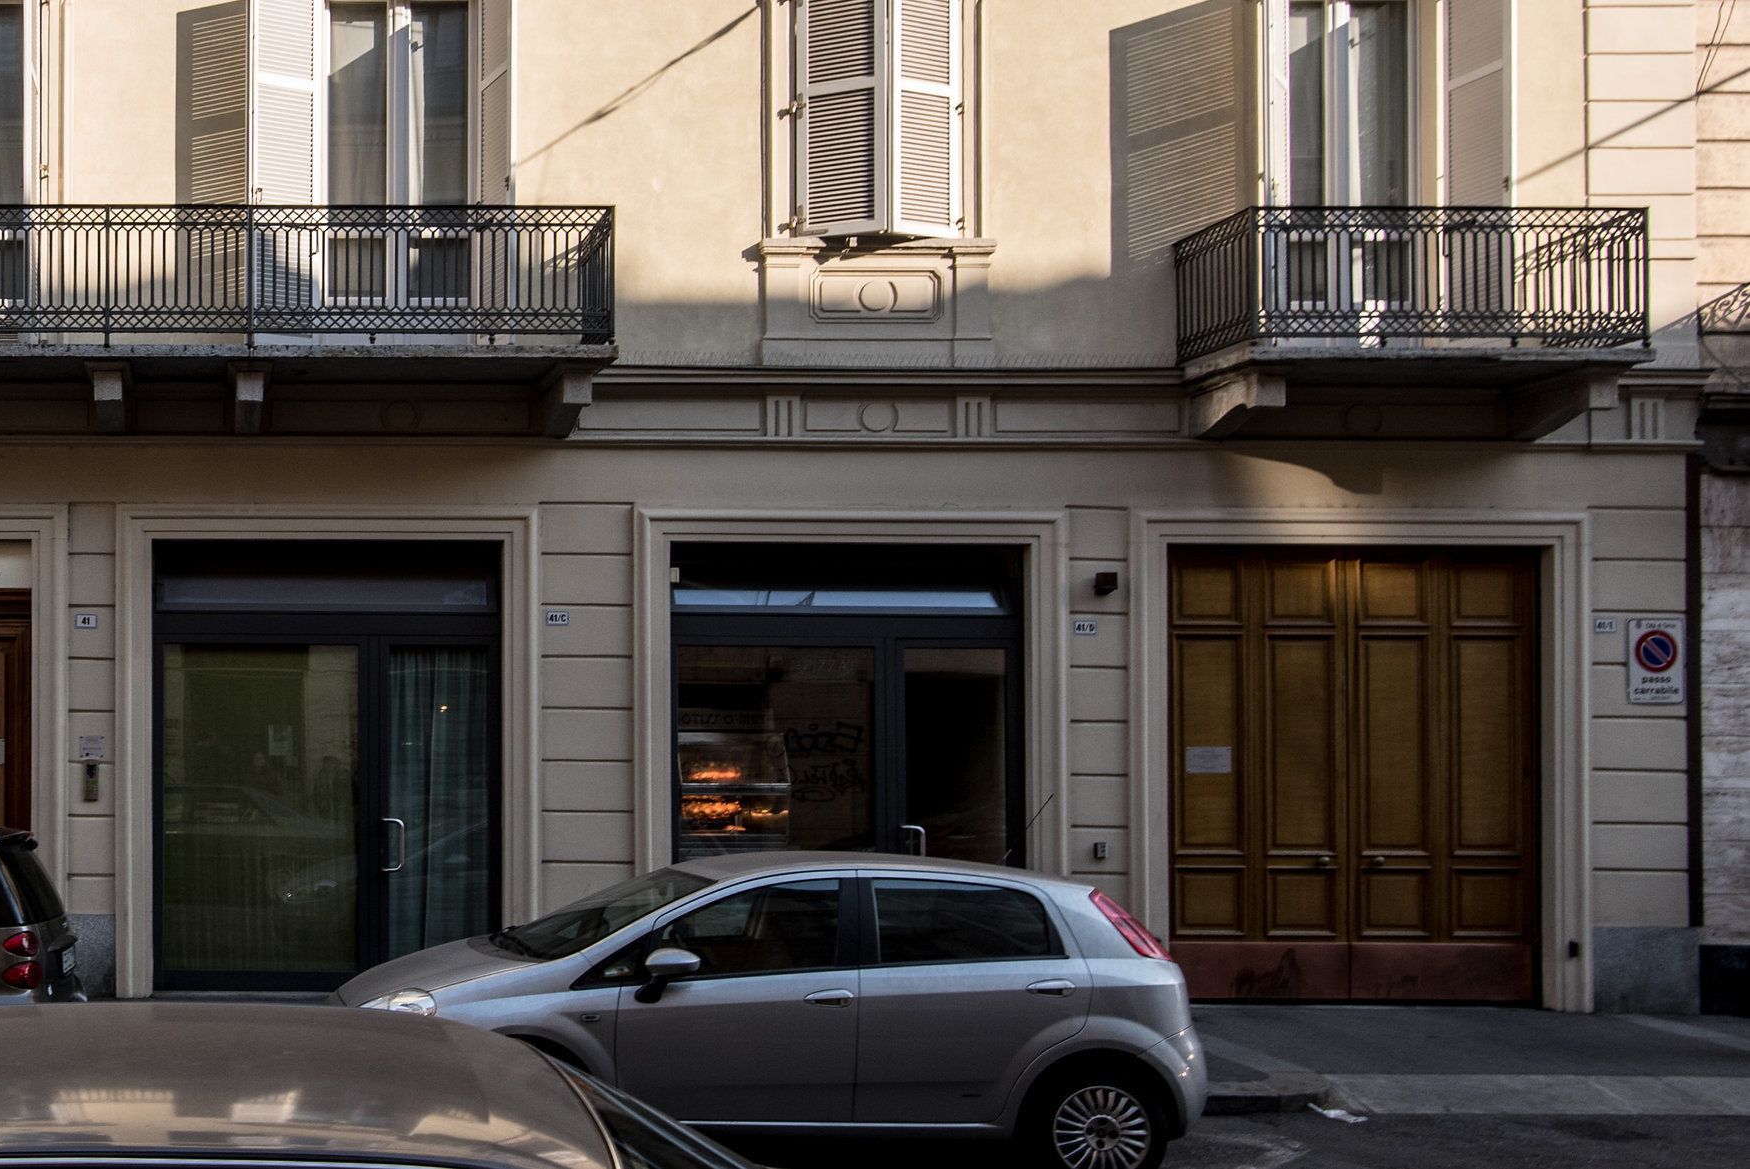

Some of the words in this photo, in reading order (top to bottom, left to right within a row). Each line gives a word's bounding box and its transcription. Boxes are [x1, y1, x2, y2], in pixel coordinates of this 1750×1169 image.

[81, 616, 90, 625] 41
[549, 613, 567, 623] 41/C
[1075, 623, 1095, 632] 41/D
[1641, 676, 1672, 685] passo
[1633, 685, 1680, 695] carrabile
